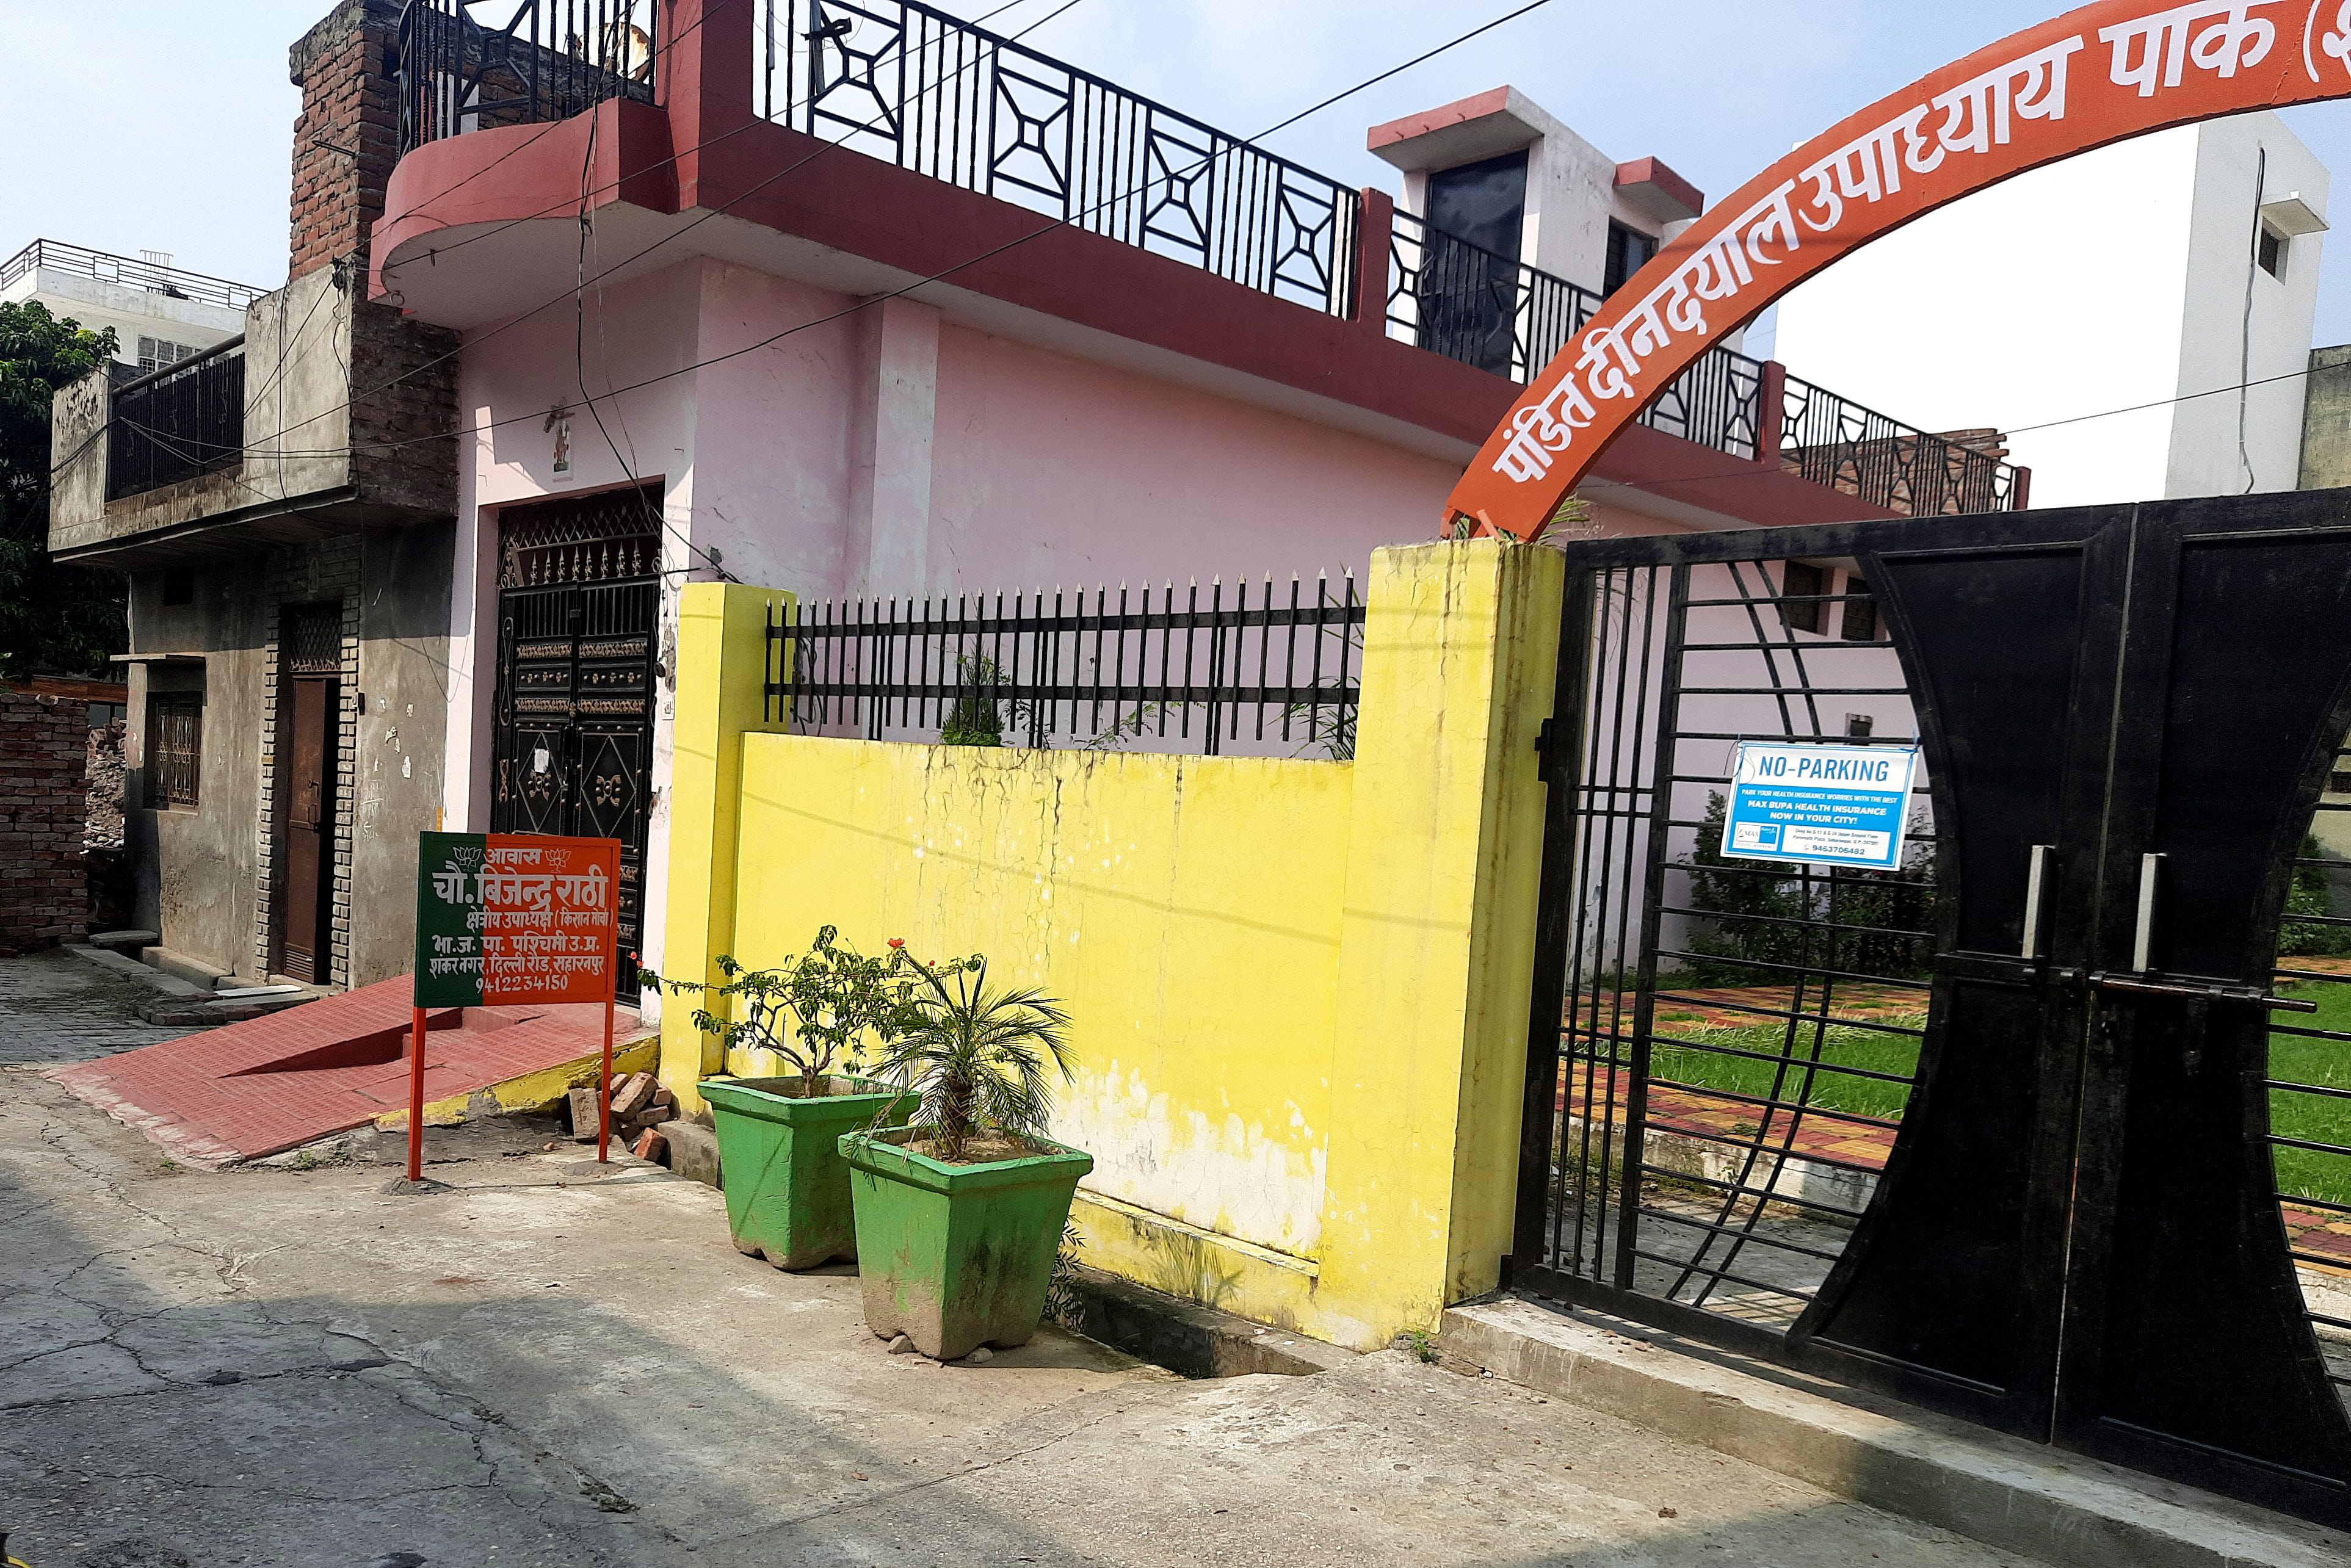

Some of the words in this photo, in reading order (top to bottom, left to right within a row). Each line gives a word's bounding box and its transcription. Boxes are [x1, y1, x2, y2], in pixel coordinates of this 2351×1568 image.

[1491, 371, 1596, 483] पंडित
[1798, 34, 2084, 232] उपाध्याय
[1759, 756, 1889, 782] NO-PARKING
[1769, 801, 1793, 809] BUPA
[1795, 803, 1831, 812] HEALTH
[1832, 804, 1887, 815] INSURANCE
[1833, 815, 1858, 824] CITY!
[484, 848, 542, 865] आवास
[556, 864, 609, 908] राठी
[466, 905, 502, 933] क्षेत्रीय
[502, 911, 553, 933] उपाध्यक्ष
[510, 930, 568, 956] पश्चिमी
[429, 953, 459, 979] शंकर
[488, 952, 526, 978] दिल्ली
[553, 956, 604, 975] सहारनपुर
[475, 974, 568, 994] 9412234150
